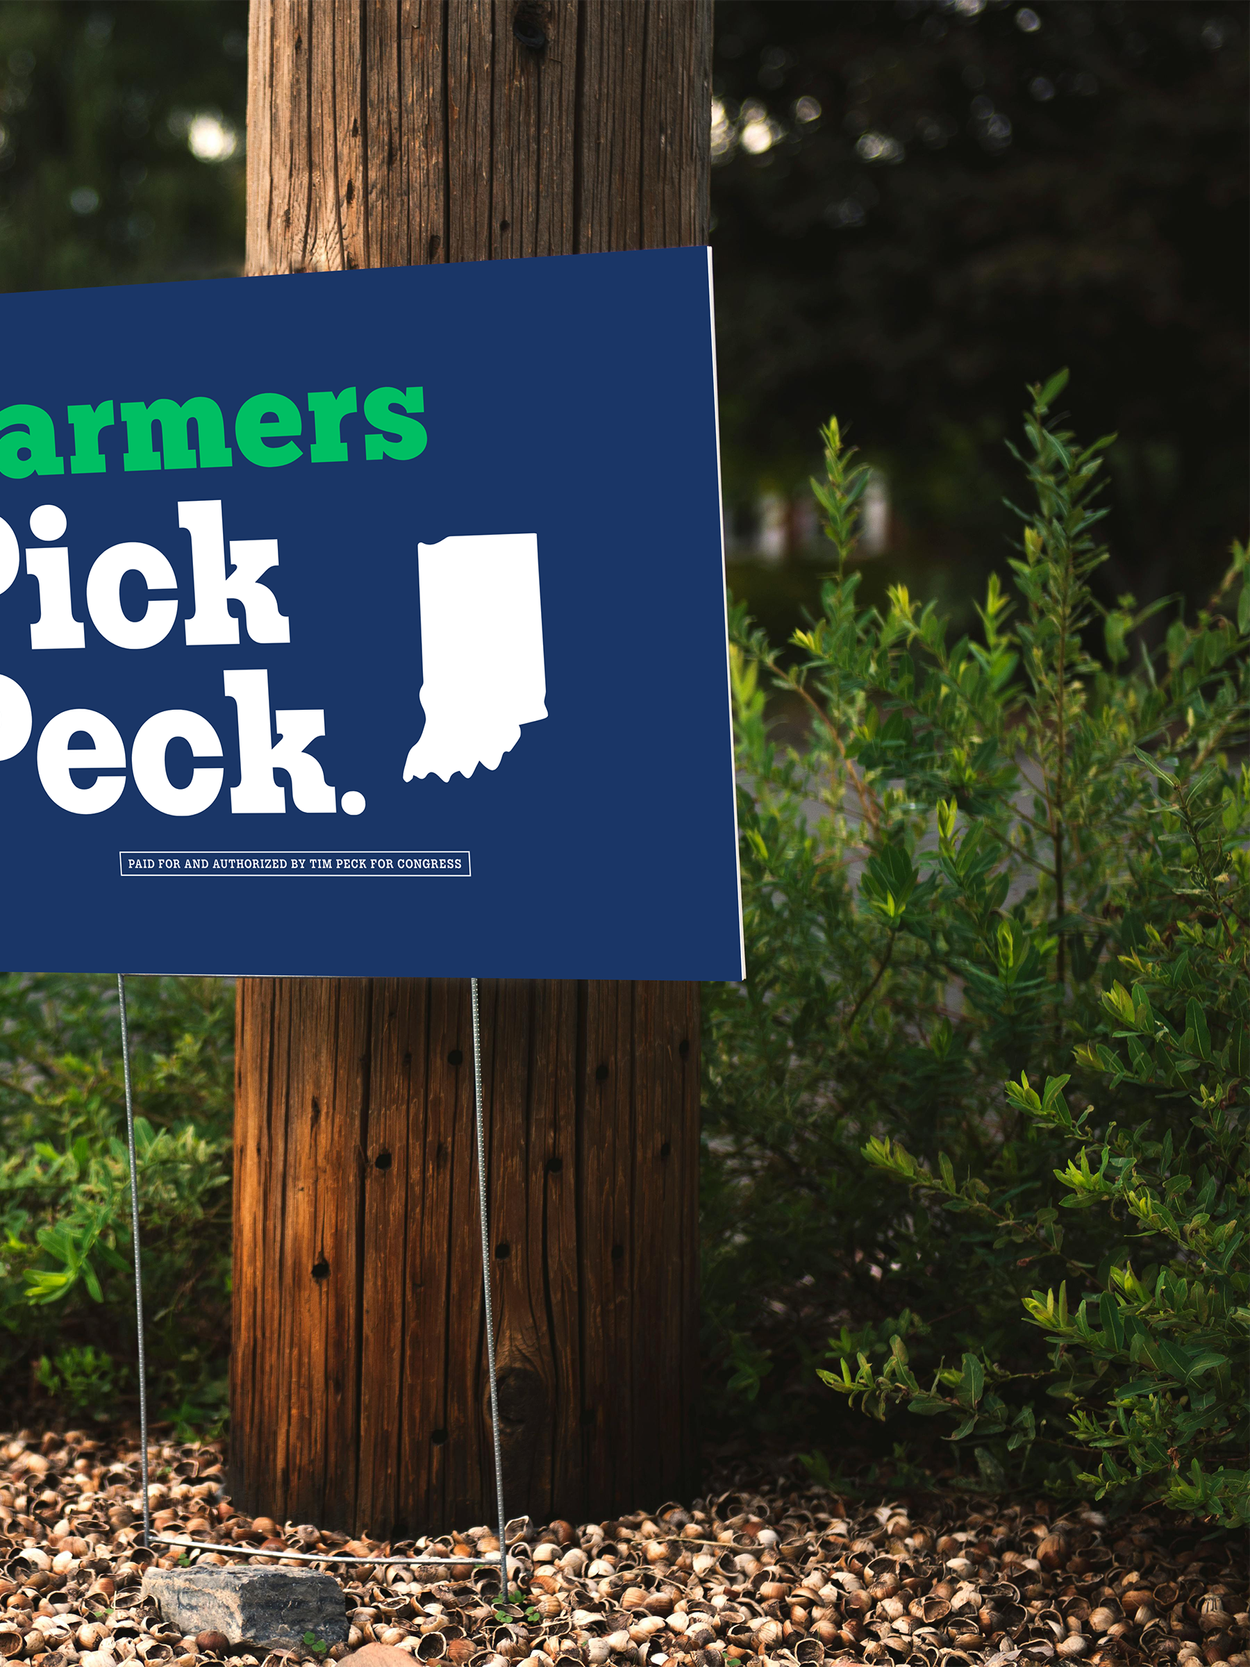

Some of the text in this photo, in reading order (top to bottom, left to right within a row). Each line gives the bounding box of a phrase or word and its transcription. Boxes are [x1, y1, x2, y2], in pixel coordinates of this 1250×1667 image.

[128, 858, 463, 869] PAID FOR AND AUTHORIZED BY TIM PECK FOR CONGRESS
